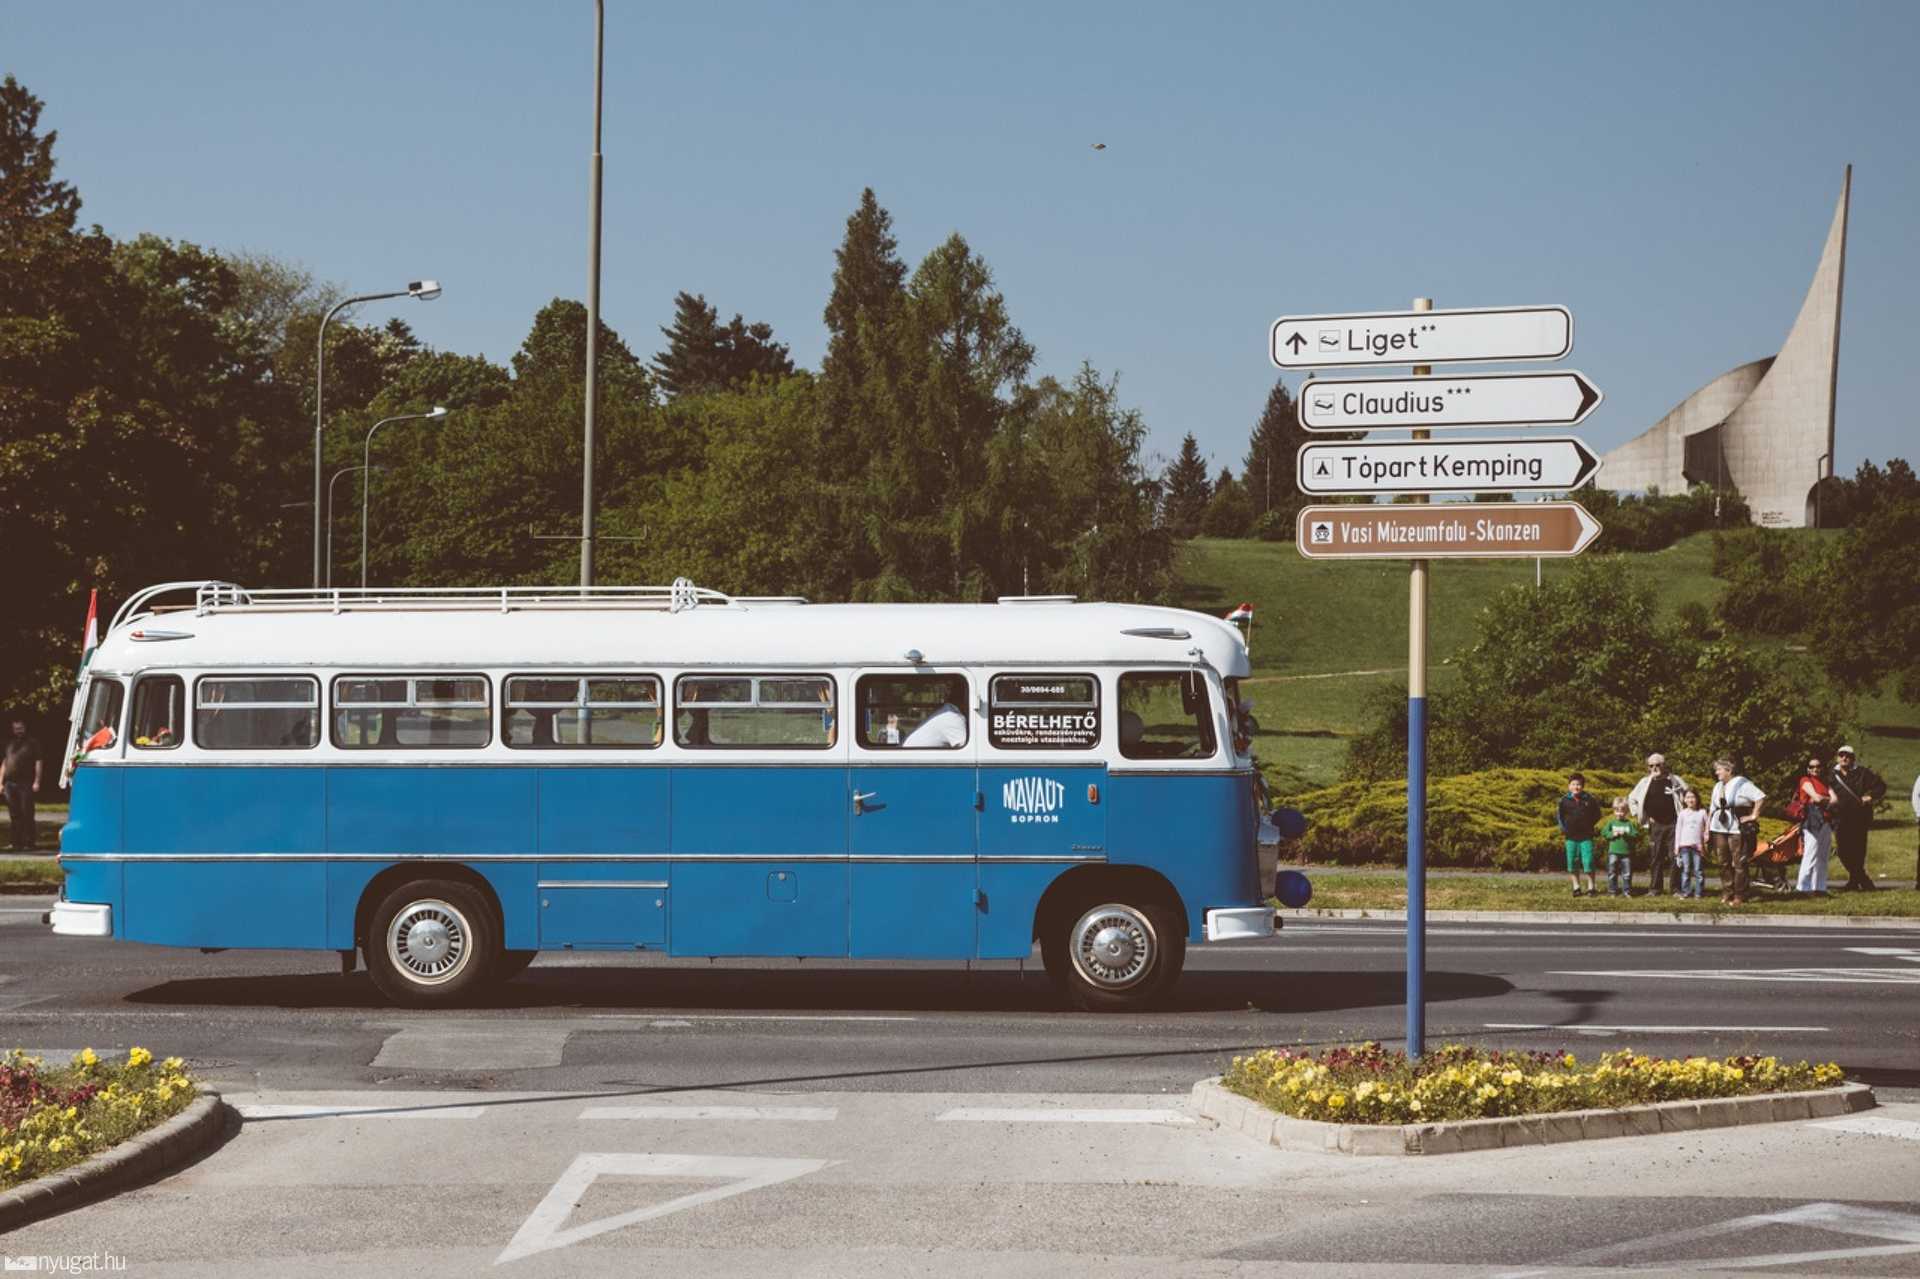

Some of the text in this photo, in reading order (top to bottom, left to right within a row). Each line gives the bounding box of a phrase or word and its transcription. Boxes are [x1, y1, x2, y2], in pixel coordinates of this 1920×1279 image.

[1341, 453, 1543, 484] Tópart Kemping
[1340, 522, 1372, 544] Vasi
[993, 711, 1096, 729] BÉRELHETŐ
[1010, 815, 1060, 824] SOPRON
